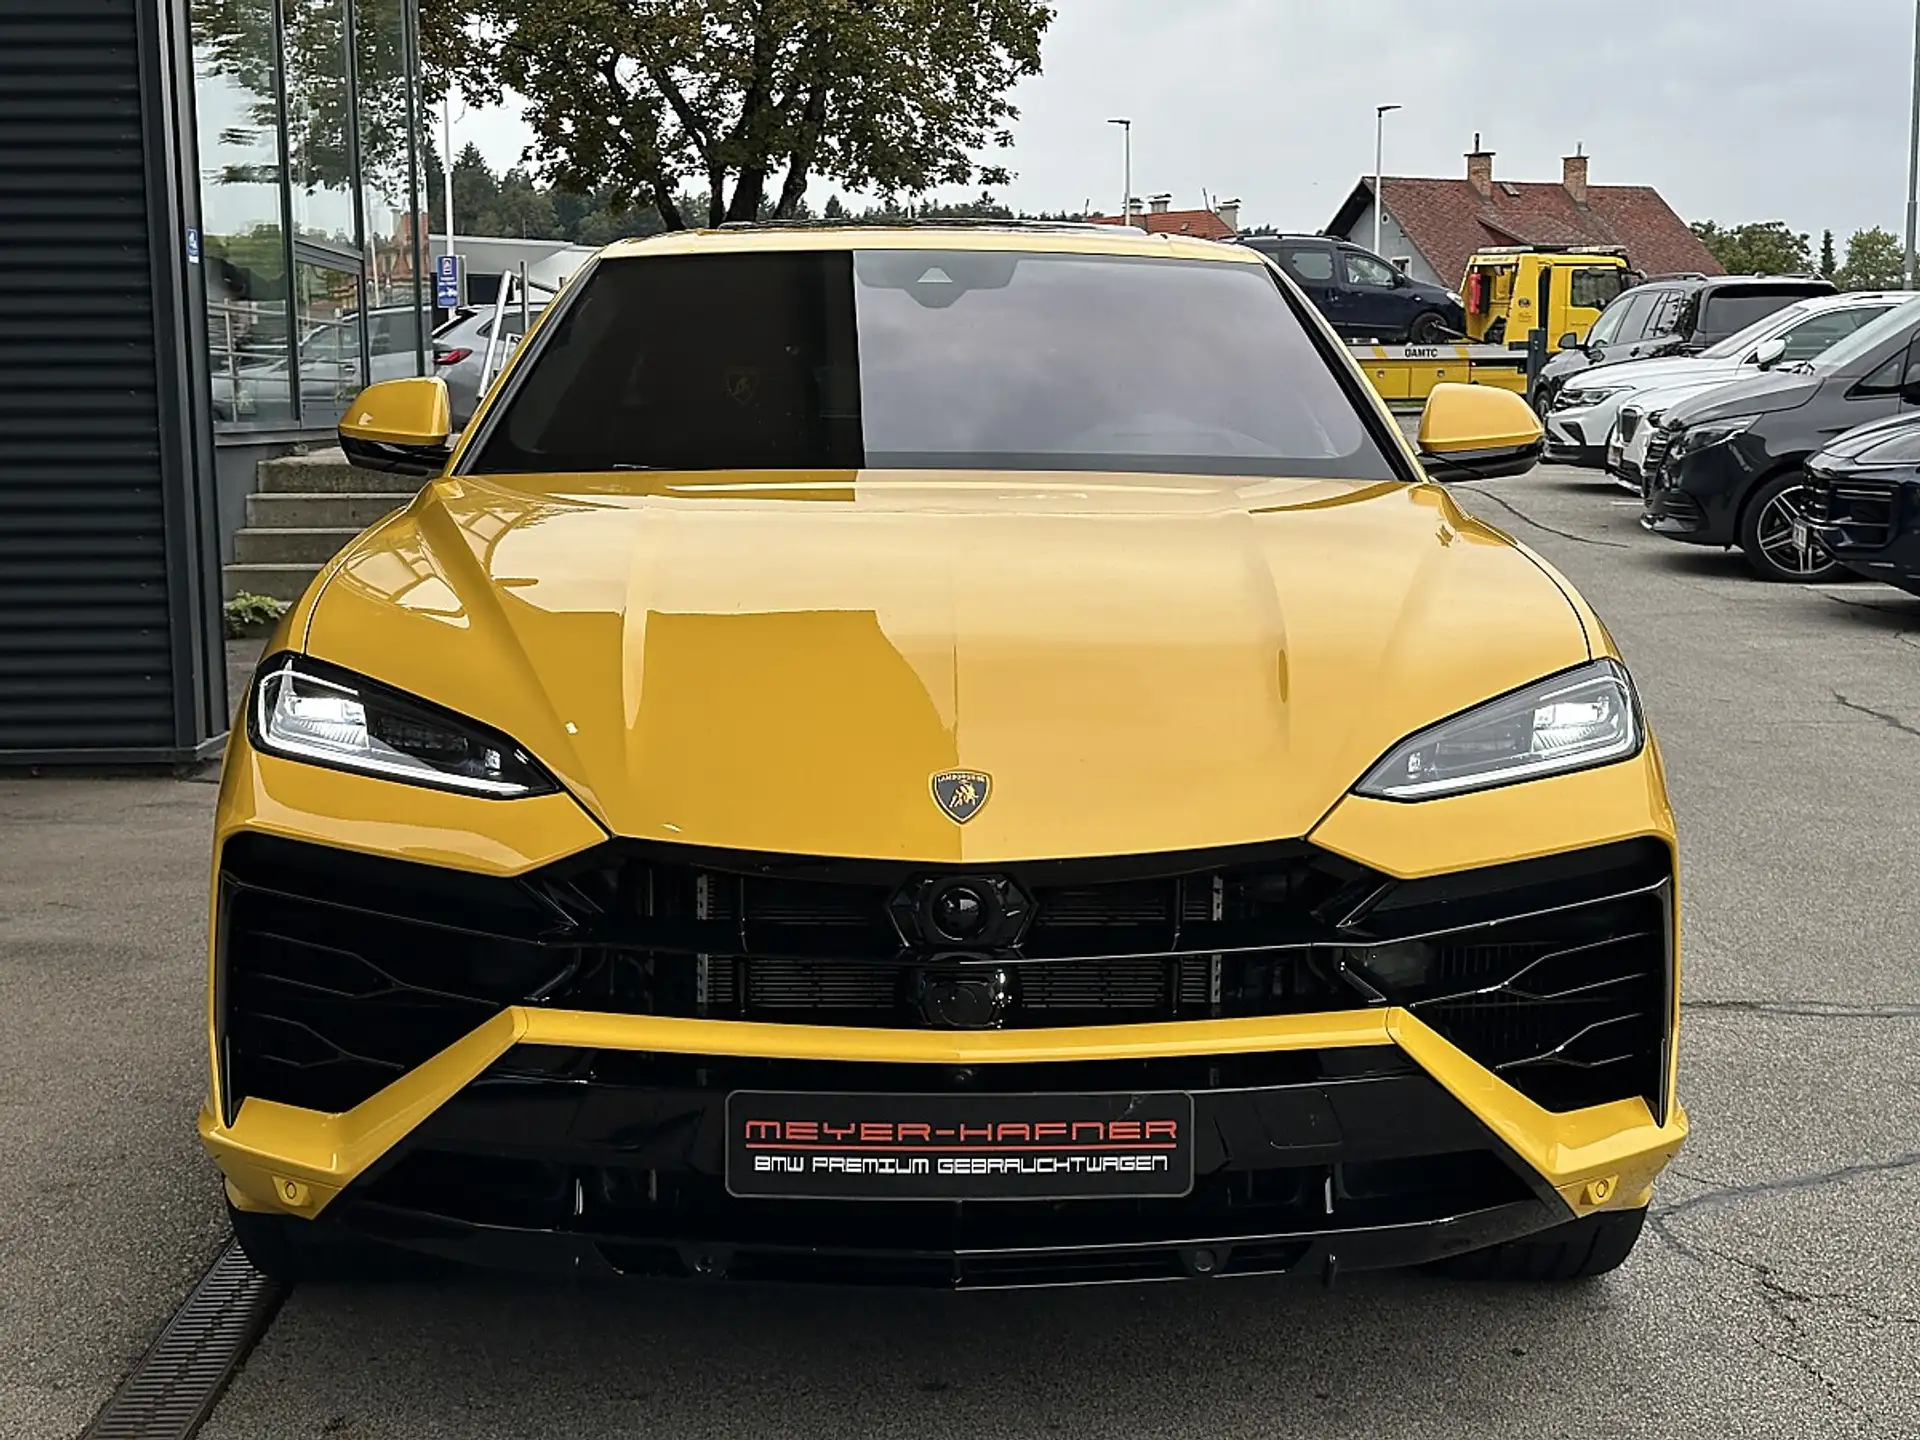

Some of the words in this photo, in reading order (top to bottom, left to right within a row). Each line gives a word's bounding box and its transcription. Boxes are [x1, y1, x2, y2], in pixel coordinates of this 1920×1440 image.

[745, 1120, 1177, 1141] MEYER-HAFNER
[754, 1155, 804, 1173] BMW
[812, 1156, 929, 1174] PREMIUM
[937, 1155, 1168, 1174] GEBRAUCHTWAGEN
